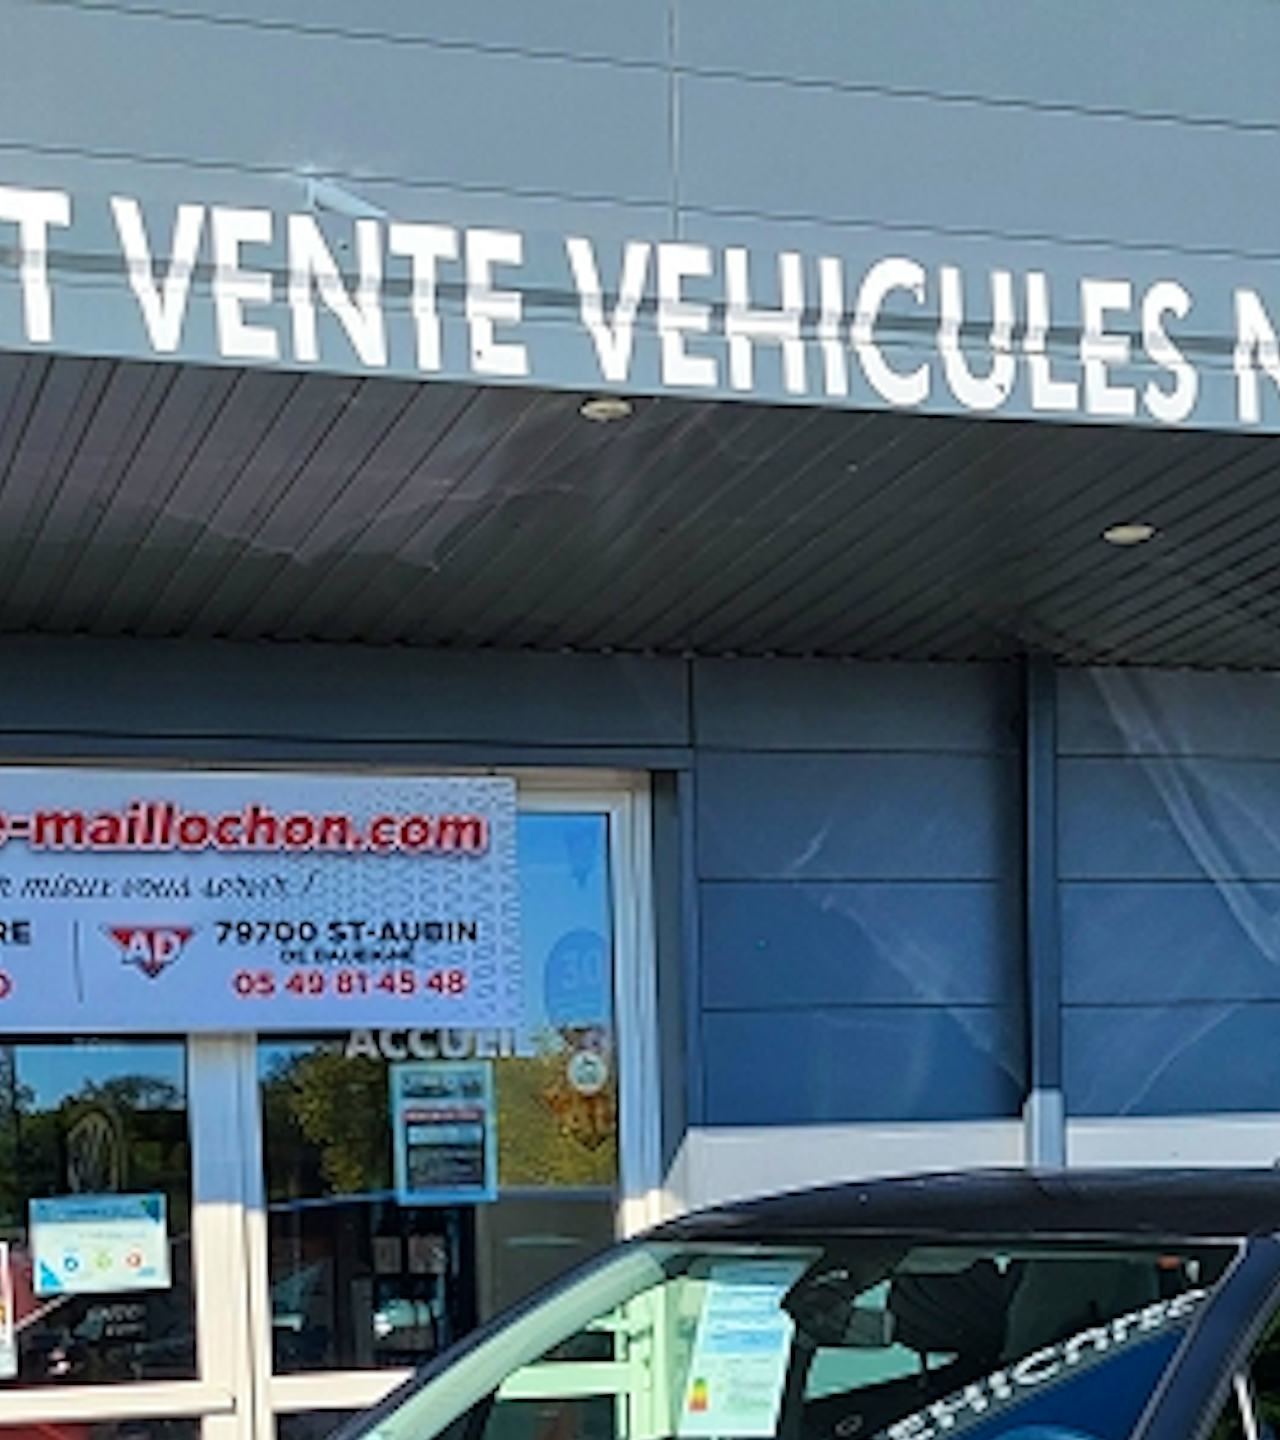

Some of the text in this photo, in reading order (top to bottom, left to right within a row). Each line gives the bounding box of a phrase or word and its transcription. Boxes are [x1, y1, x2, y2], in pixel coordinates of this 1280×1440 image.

[111, 196, 529, 376] VENTE
[566, 238, 1197, 423] VEHICULES
[215, 921, 479, 944] 79700 ST-AUBIN
[125, 933, 181, 964] AD
[234, 971, 468, 995] 05 49 81 45 48
